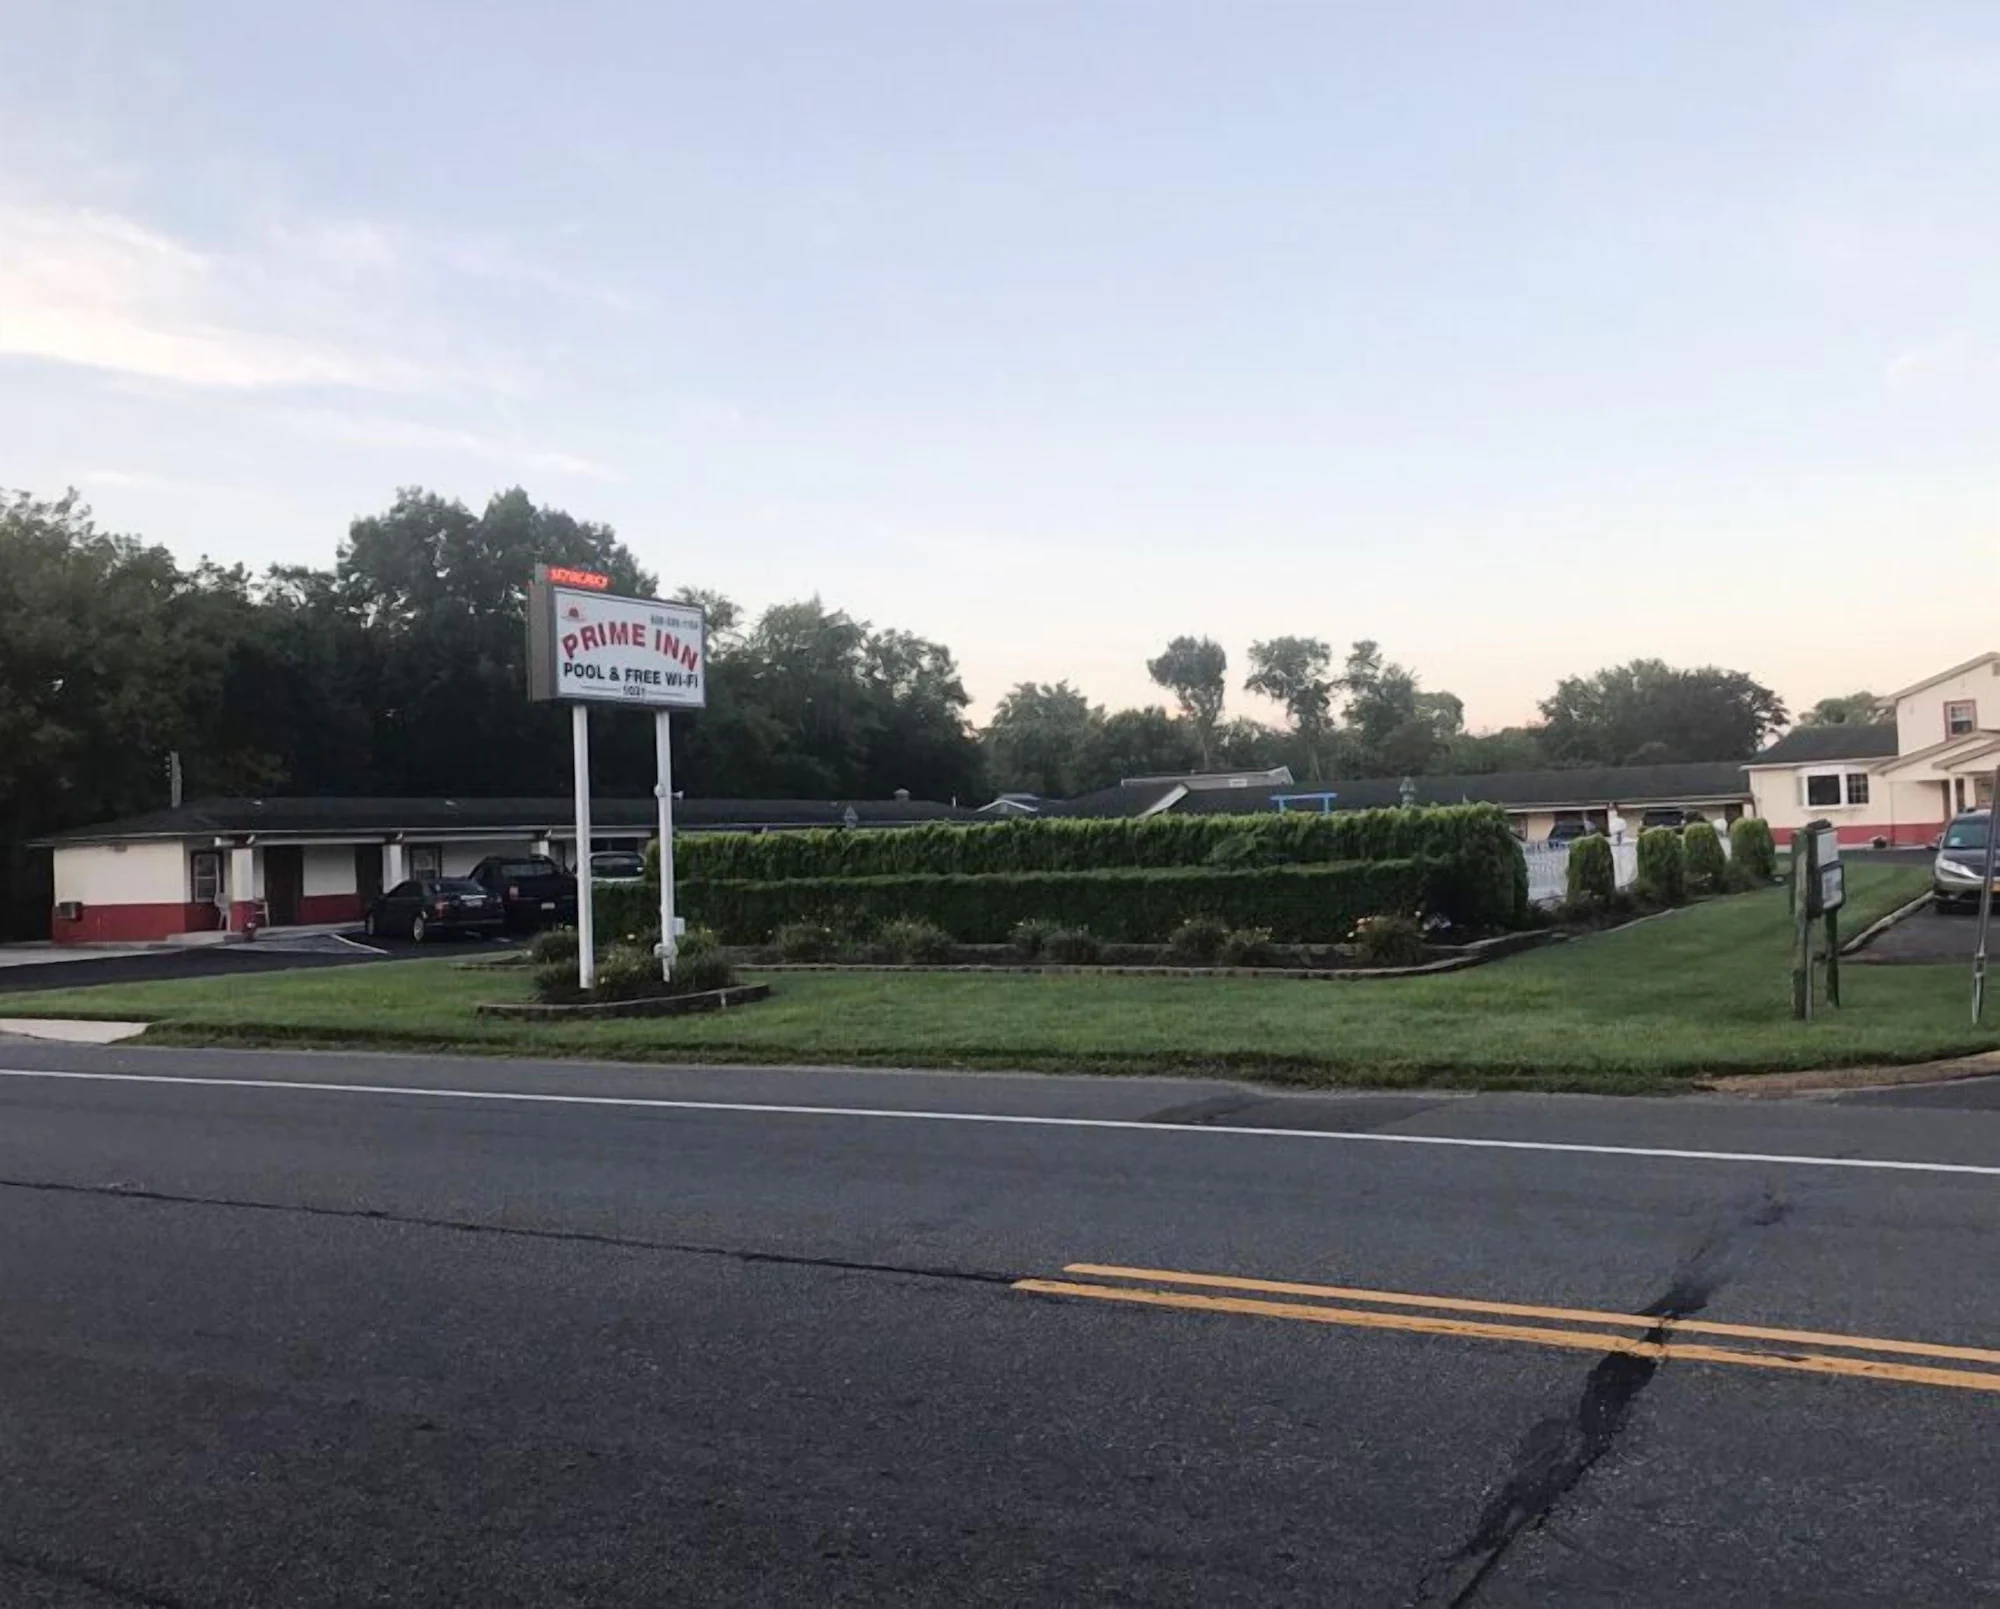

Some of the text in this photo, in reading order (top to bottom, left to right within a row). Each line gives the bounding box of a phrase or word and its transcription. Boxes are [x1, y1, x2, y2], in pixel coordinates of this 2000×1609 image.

[562, 621, 698, 672] PRIME INN
[564, 662, 698, 689] POOL & FREE WI-FI
